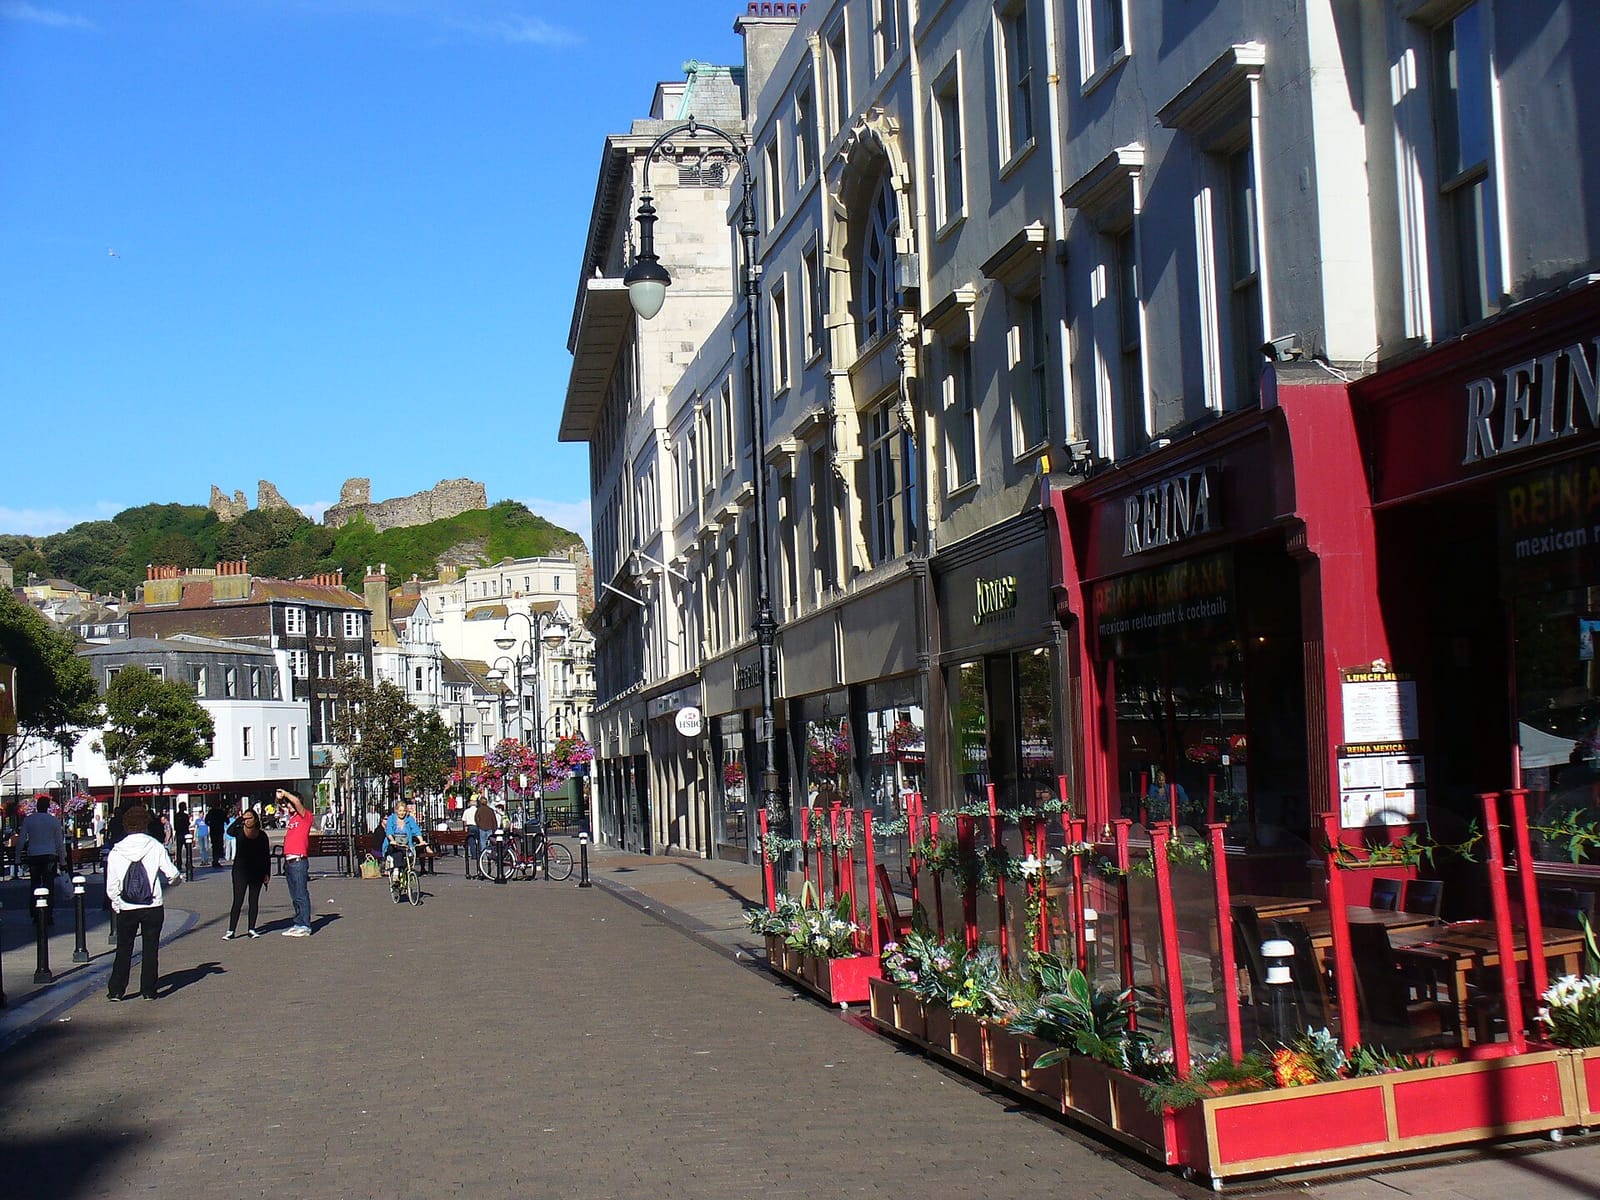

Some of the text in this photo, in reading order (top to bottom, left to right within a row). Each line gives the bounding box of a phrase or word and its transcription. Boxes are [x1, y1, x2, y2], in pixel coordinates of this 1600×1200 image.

[1122, 464, 1212, 557] REINA
[1514, 526, 1588, 559] mexican
[1095, 559, 1228, 614] REINA MEXICANA
[1099, 595, 1228, 638] mexican restaurant & cocktails
[1346, 672, 1381, 682] LUNCH
[679, 720, 703, 728] HSBC
[1346, 744, 1373, 754] REINA
[197, 783, 221, 791] COSTA
